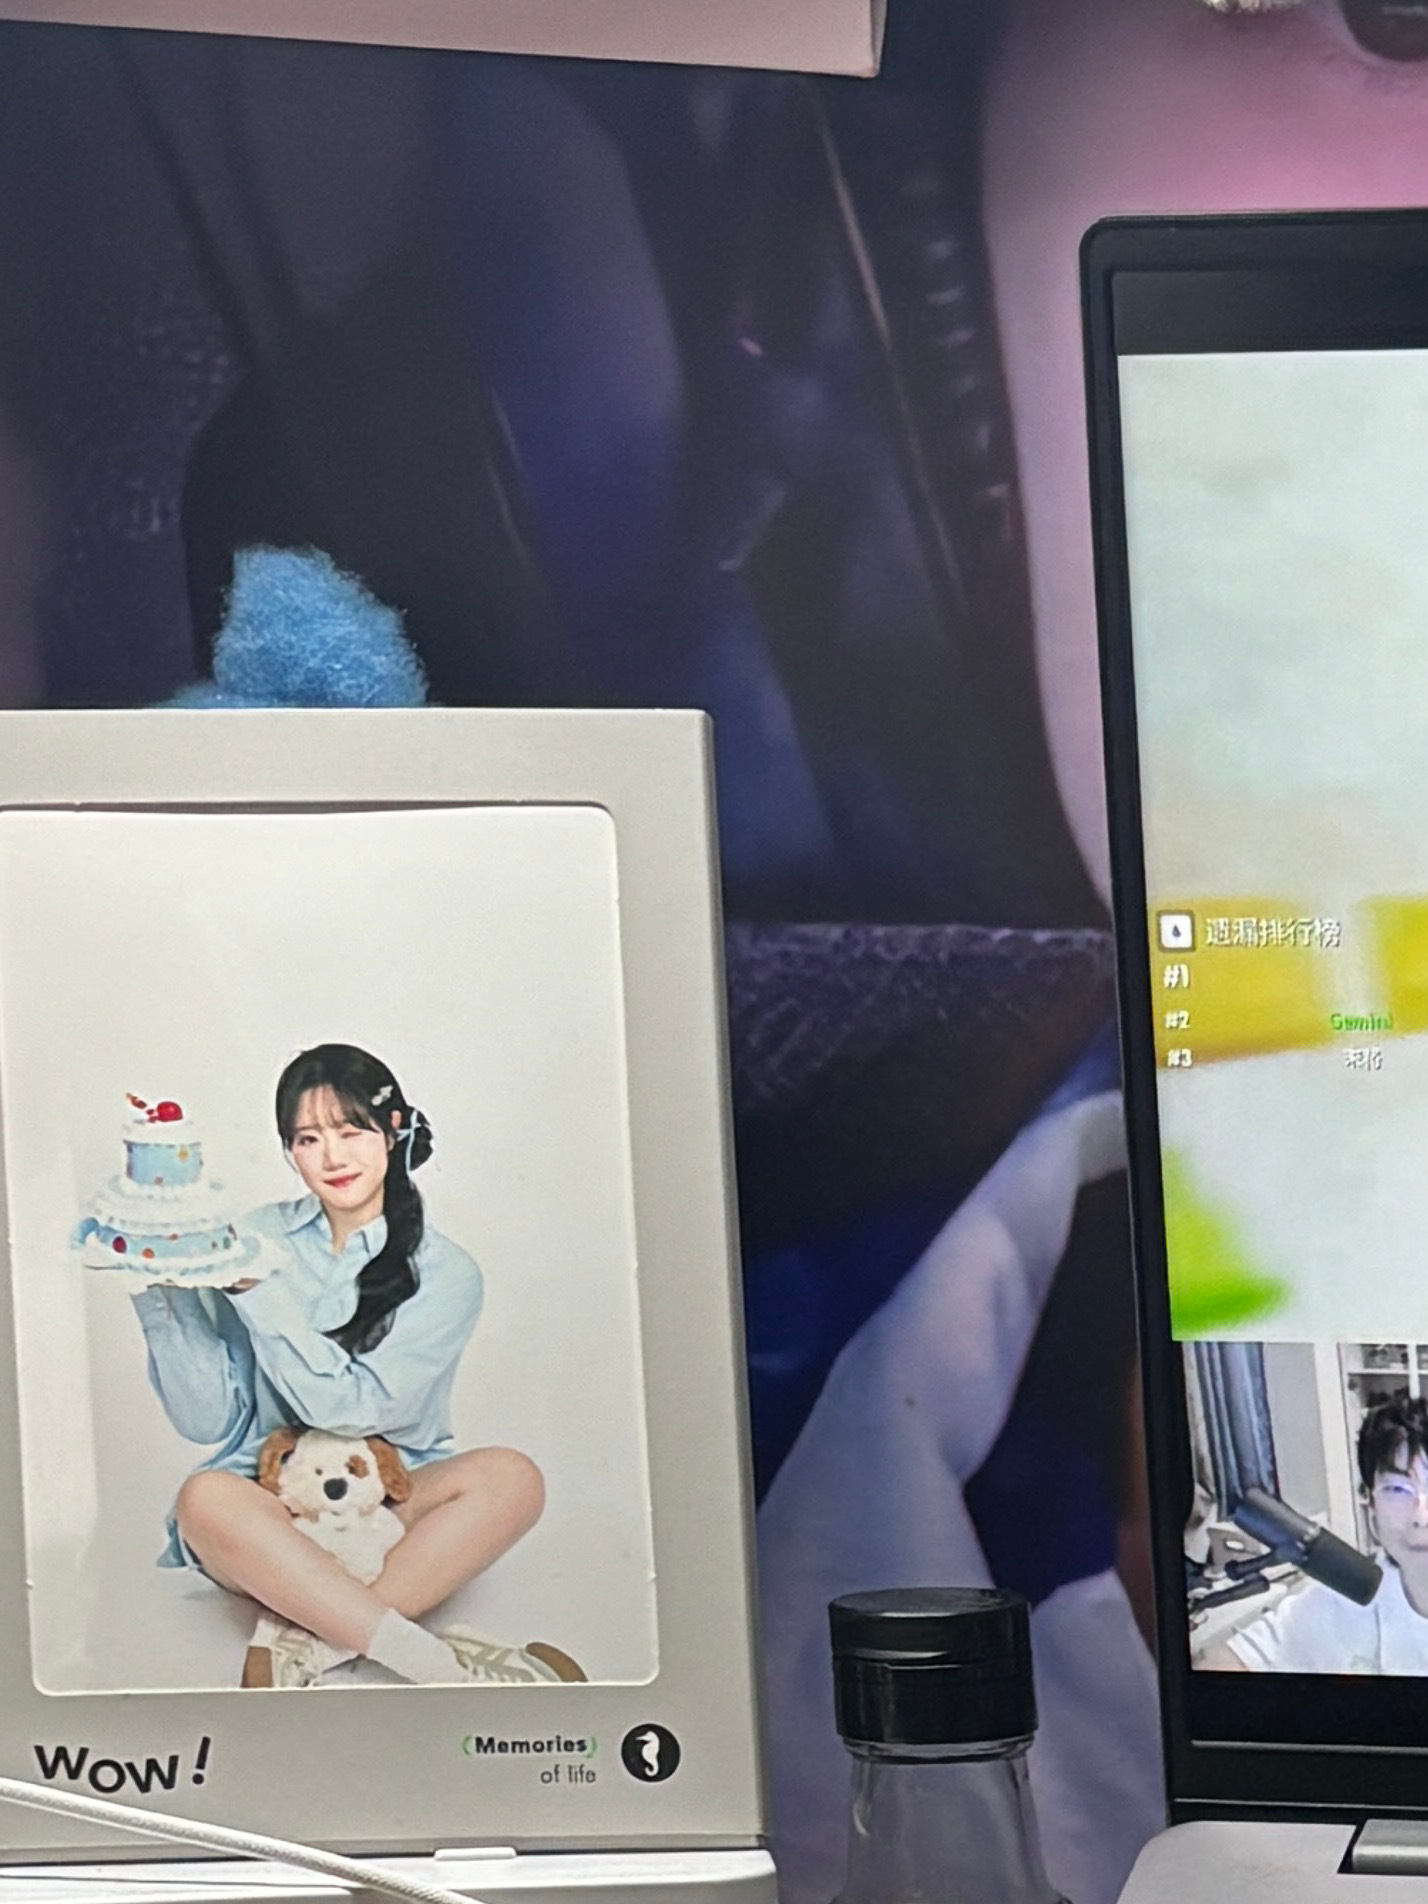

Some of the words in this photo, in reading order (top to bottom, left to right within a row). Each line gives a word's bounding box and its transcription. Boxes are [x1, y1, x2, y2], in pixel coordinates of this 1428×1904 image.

[34, 1737, 212, 1794] WOW!
[540, 1763, 562, 1784] of
[566, 1763, 597, 1784] life
